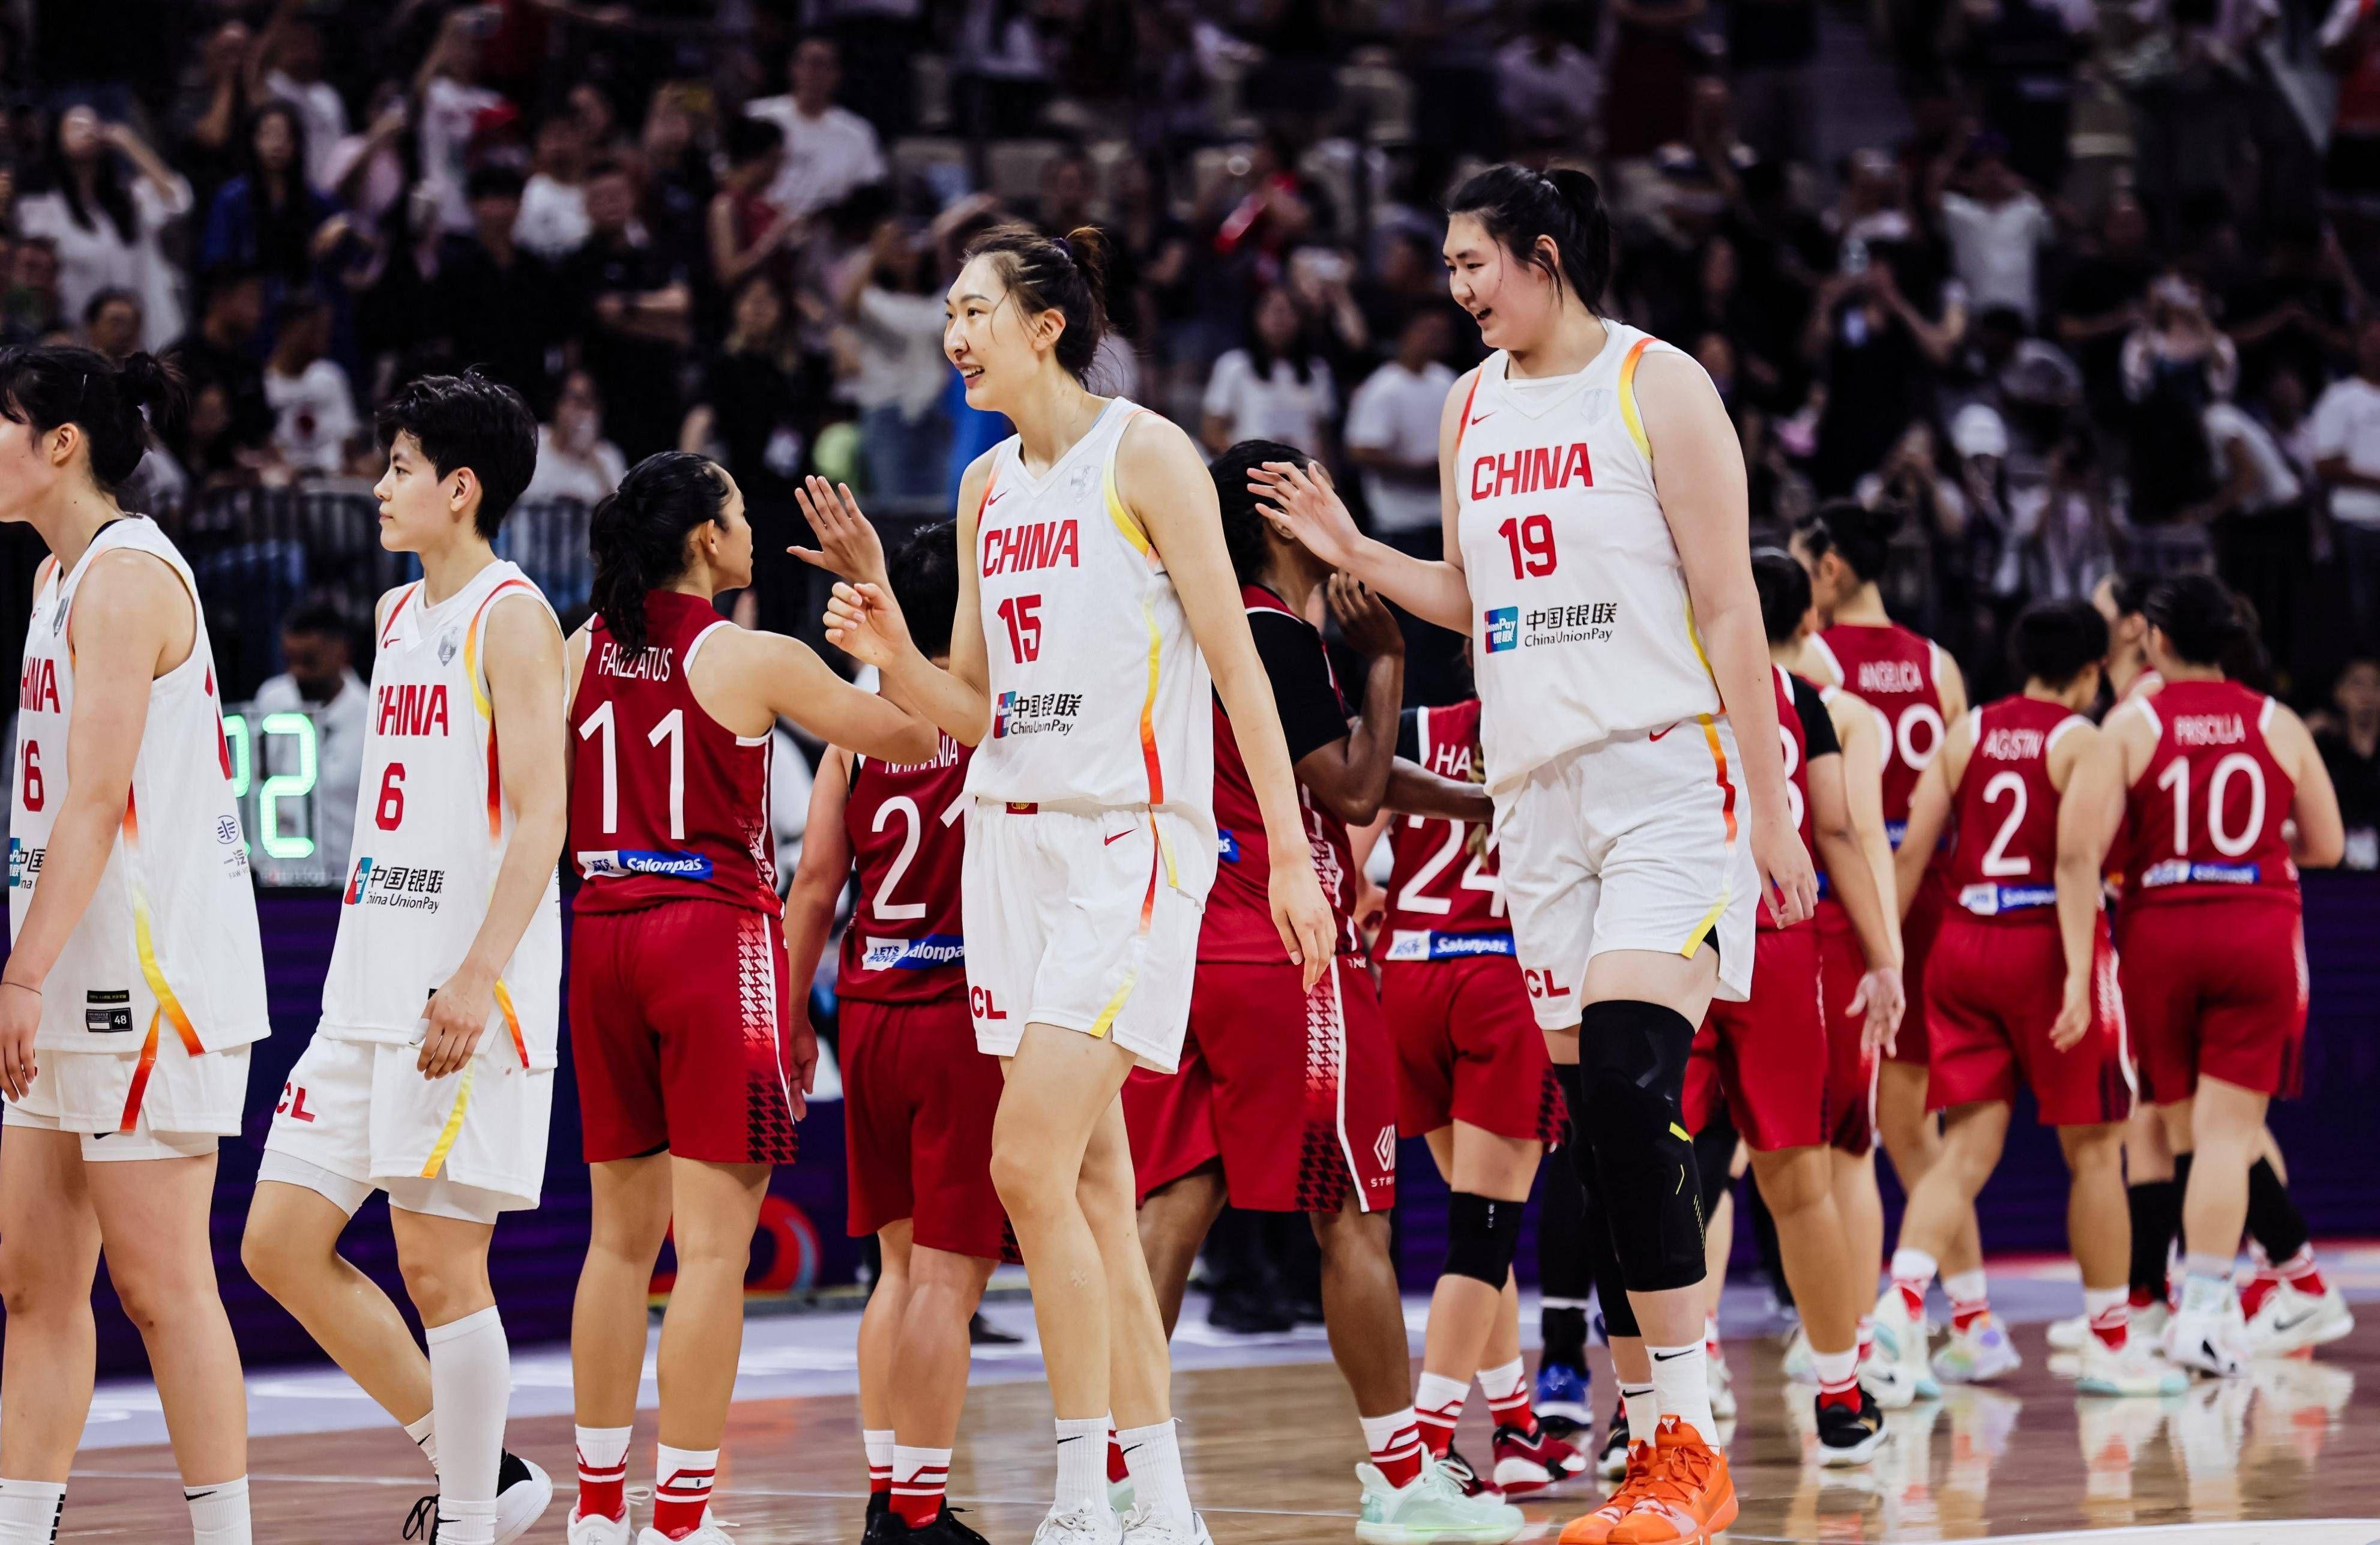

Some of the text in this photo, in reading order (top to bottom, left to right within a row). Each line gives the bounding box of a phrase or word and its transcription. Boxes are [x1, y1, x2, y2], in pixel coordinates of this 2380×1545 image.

[1471, 442, 1594, 501] CHINA
[983, 519, 1079, 577] CHINA
[1498, 514, 1558, 580] 19
[997, 593, 1041, 664] 15
[1526, 603, 1618, 631] 中国银联
[20, 655, 61, 714] HINA
[1014, 694, 1083, 718] 中国银联
[375, 762, 406, 831] 6
[579, 700, 685, 840] 11
[1981, 770, 2031, 876] 2
[2159, 752, 2267, 857] 10
[370, 865, 445, 894] 中国银联
[1397, 813, 1508, 918] 24
[874, 945, 900, 956] LET'S
[902, 941, 964, 963] alonpa
[1436, 936, 1508, 954] Salonpas
[114, 1014, 127, 1025] 48
[971, 986, 1007, 1019] CL
